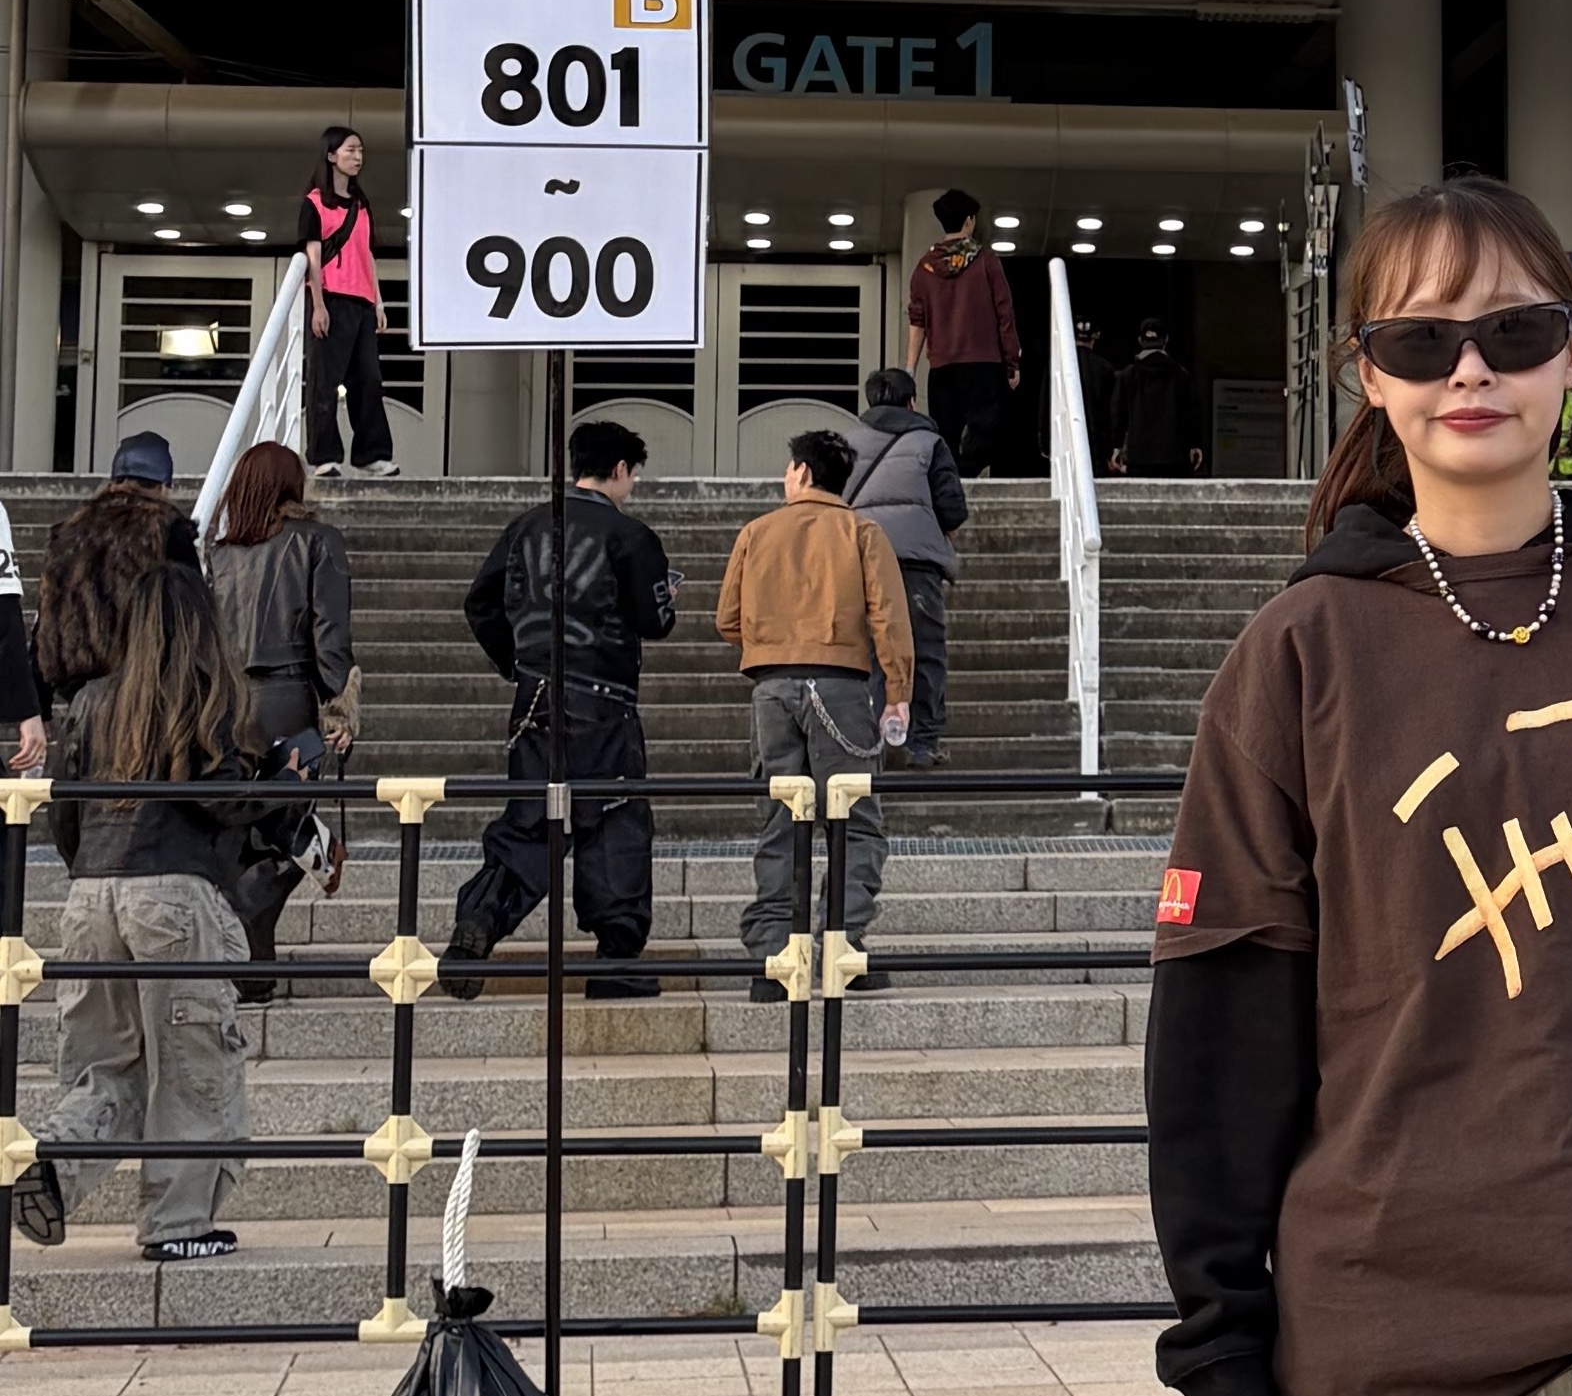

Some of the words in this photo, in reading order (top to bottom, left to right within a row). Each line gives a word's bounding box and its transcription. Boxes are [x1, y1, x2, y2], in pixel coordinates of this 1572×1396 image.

[481, 43, 640, 127] 801
[733, 32, 937, 96] GATE
[956, 22, 993, 98] 1
[466, 235, 654, 320] 900
